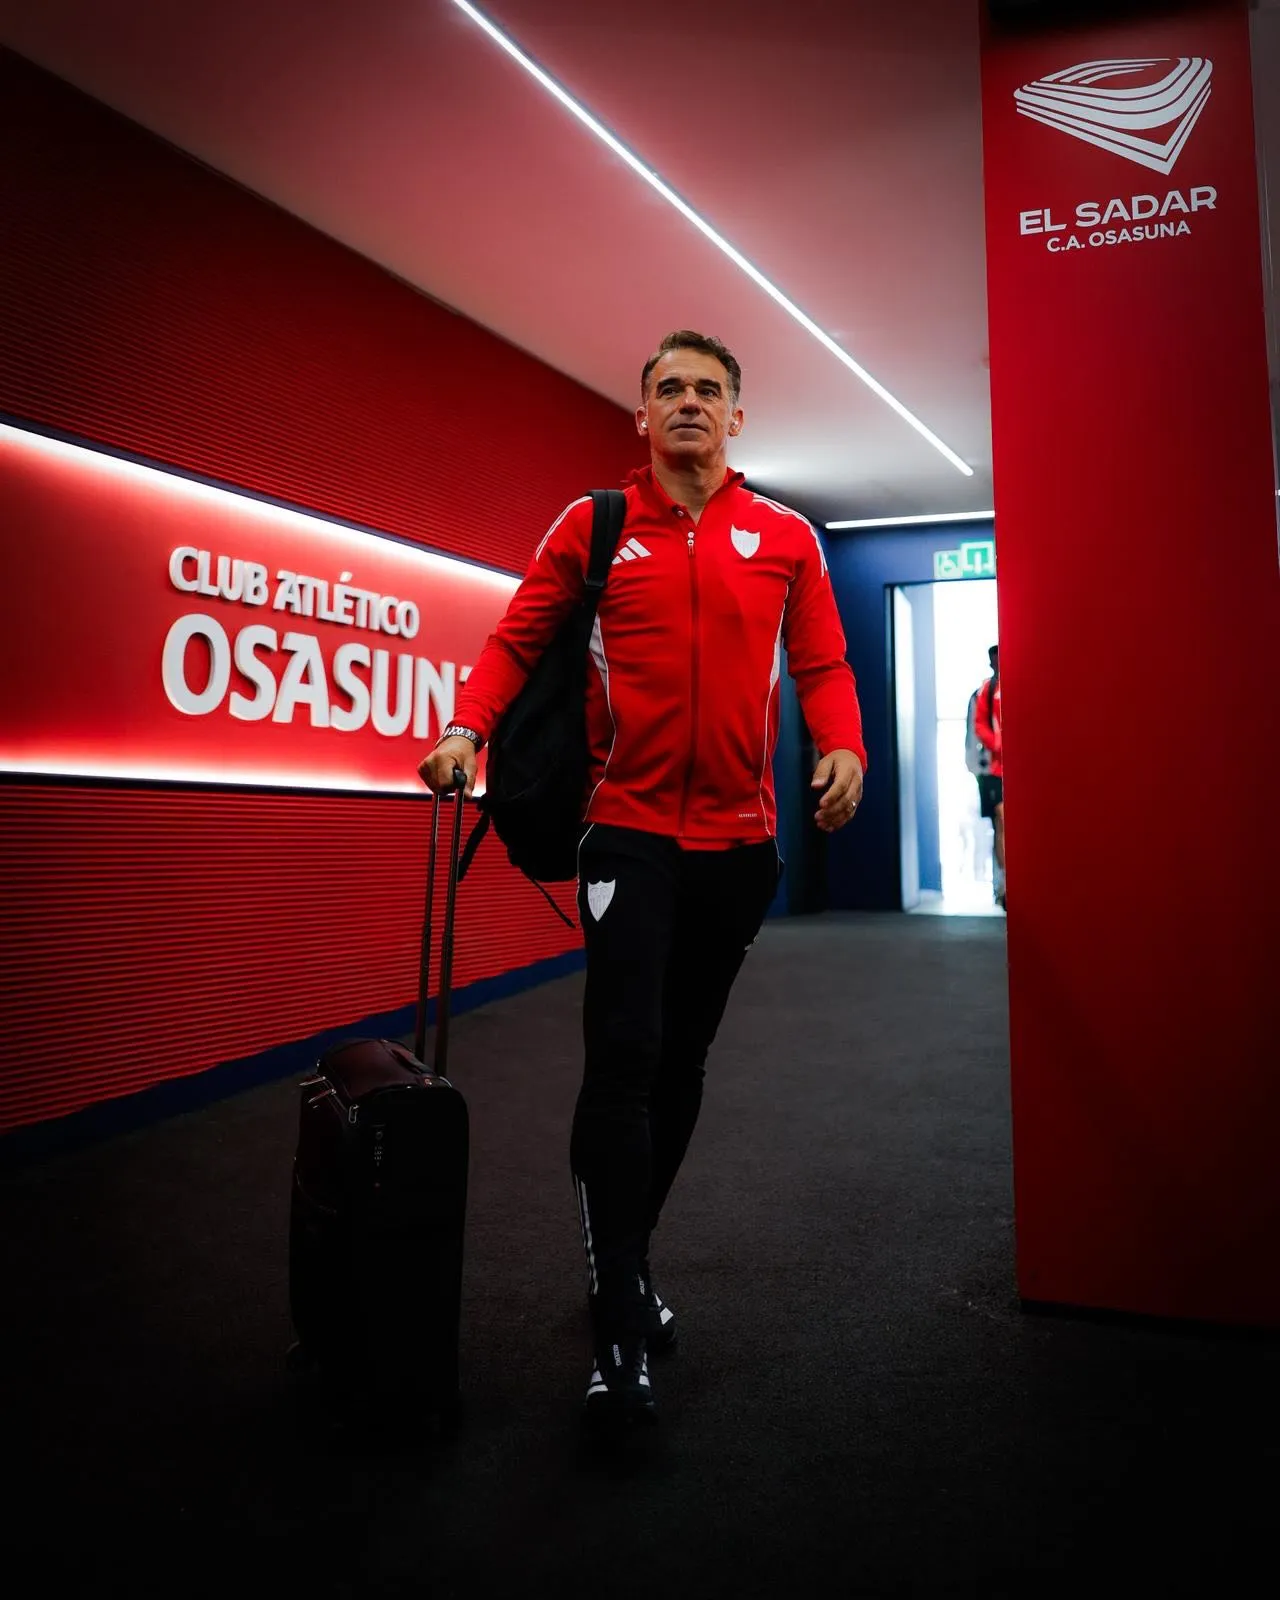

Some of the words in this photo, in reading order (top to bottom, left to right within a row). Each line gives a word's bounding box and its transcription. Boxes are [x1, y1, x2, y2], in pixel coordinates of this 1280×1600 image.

[1019, 208, 1067, 235] EL
[1075, 185, 1217, 228] SADAR
[1046, 235, 1086, 252] C.A.
[1088, 220, 1191, 246] OSASUNA
[168, 546, 269, 606] CLUB
[272, 570, 420, 639] ATLÉTICO
[161, 613, 473, 739] OSASUN
